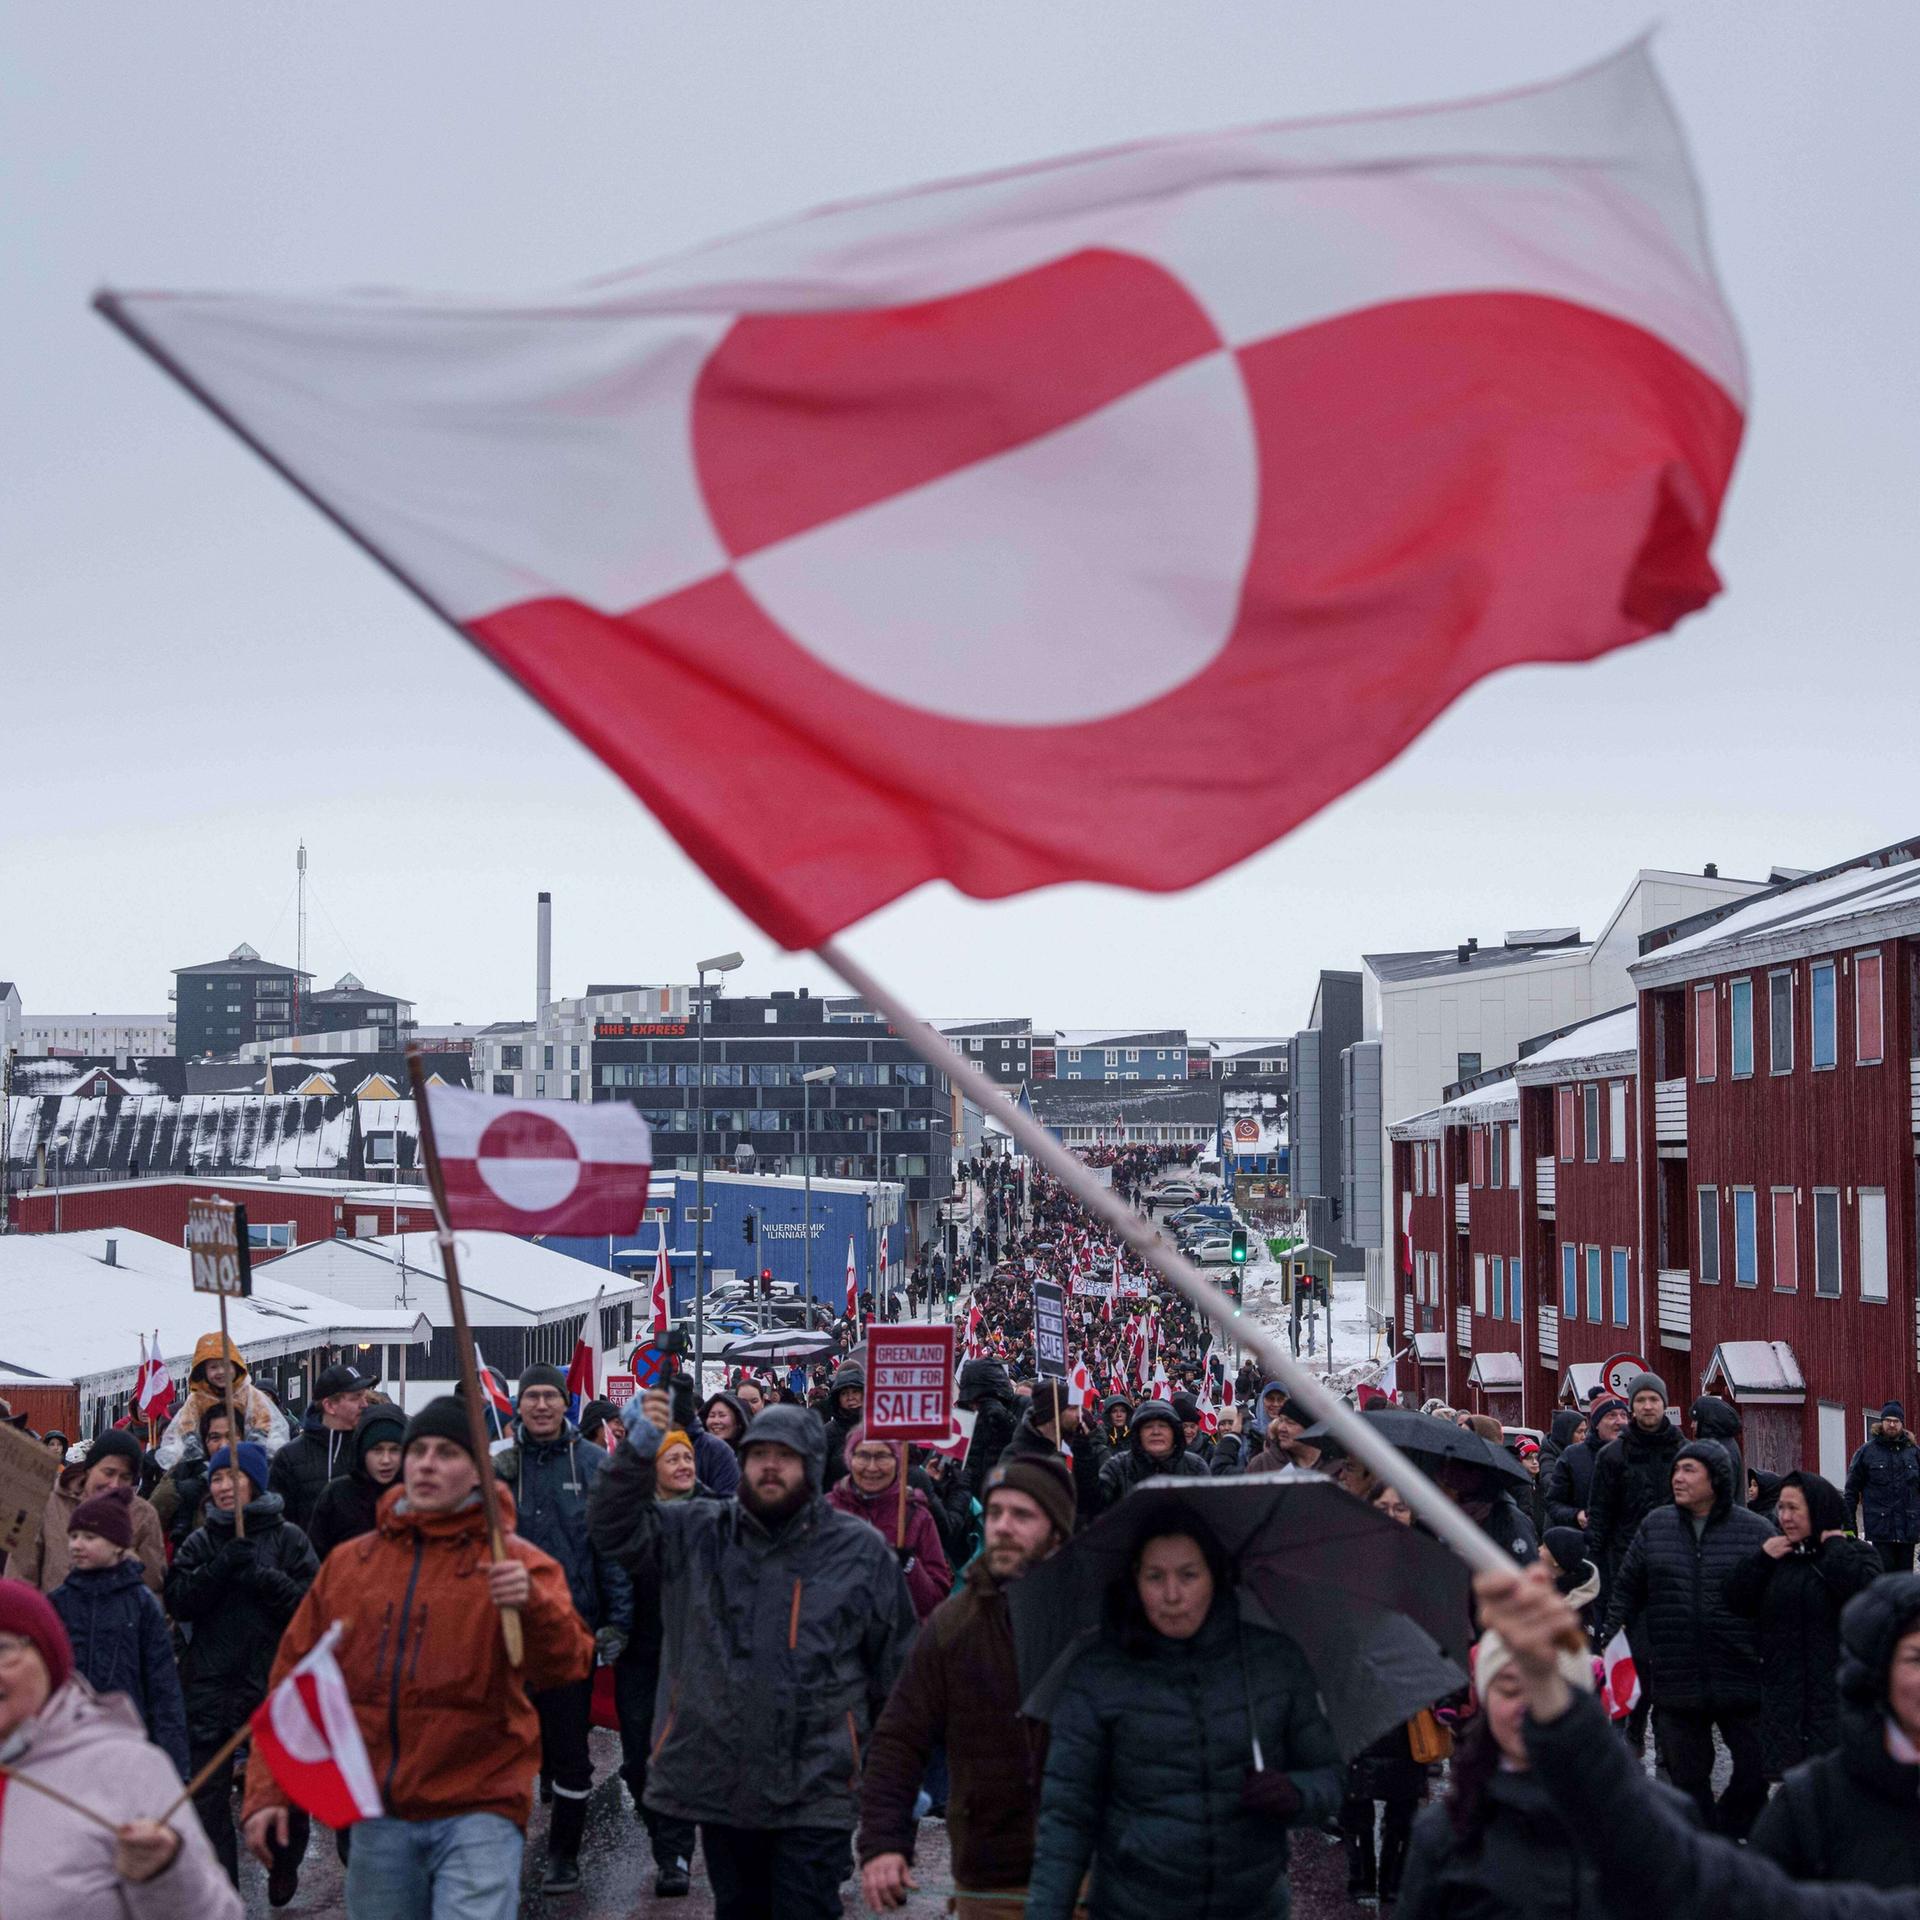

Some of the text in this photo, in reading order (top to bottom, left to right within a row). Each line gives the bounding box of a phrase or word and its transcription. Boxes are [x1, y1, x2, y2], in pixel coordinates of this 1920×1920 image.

[631, 1024, 686, 1035] EXPRESS
[767, 1231, 820, 1239] ILINNIARIK
[194, 1252, 242, 1292] NO!
[878, 1347, 942, 1361] GREENLAND
[877, 1370, 942, 1385] IS NOT FOR
[876, 1393, 940, 1423] SALE!
